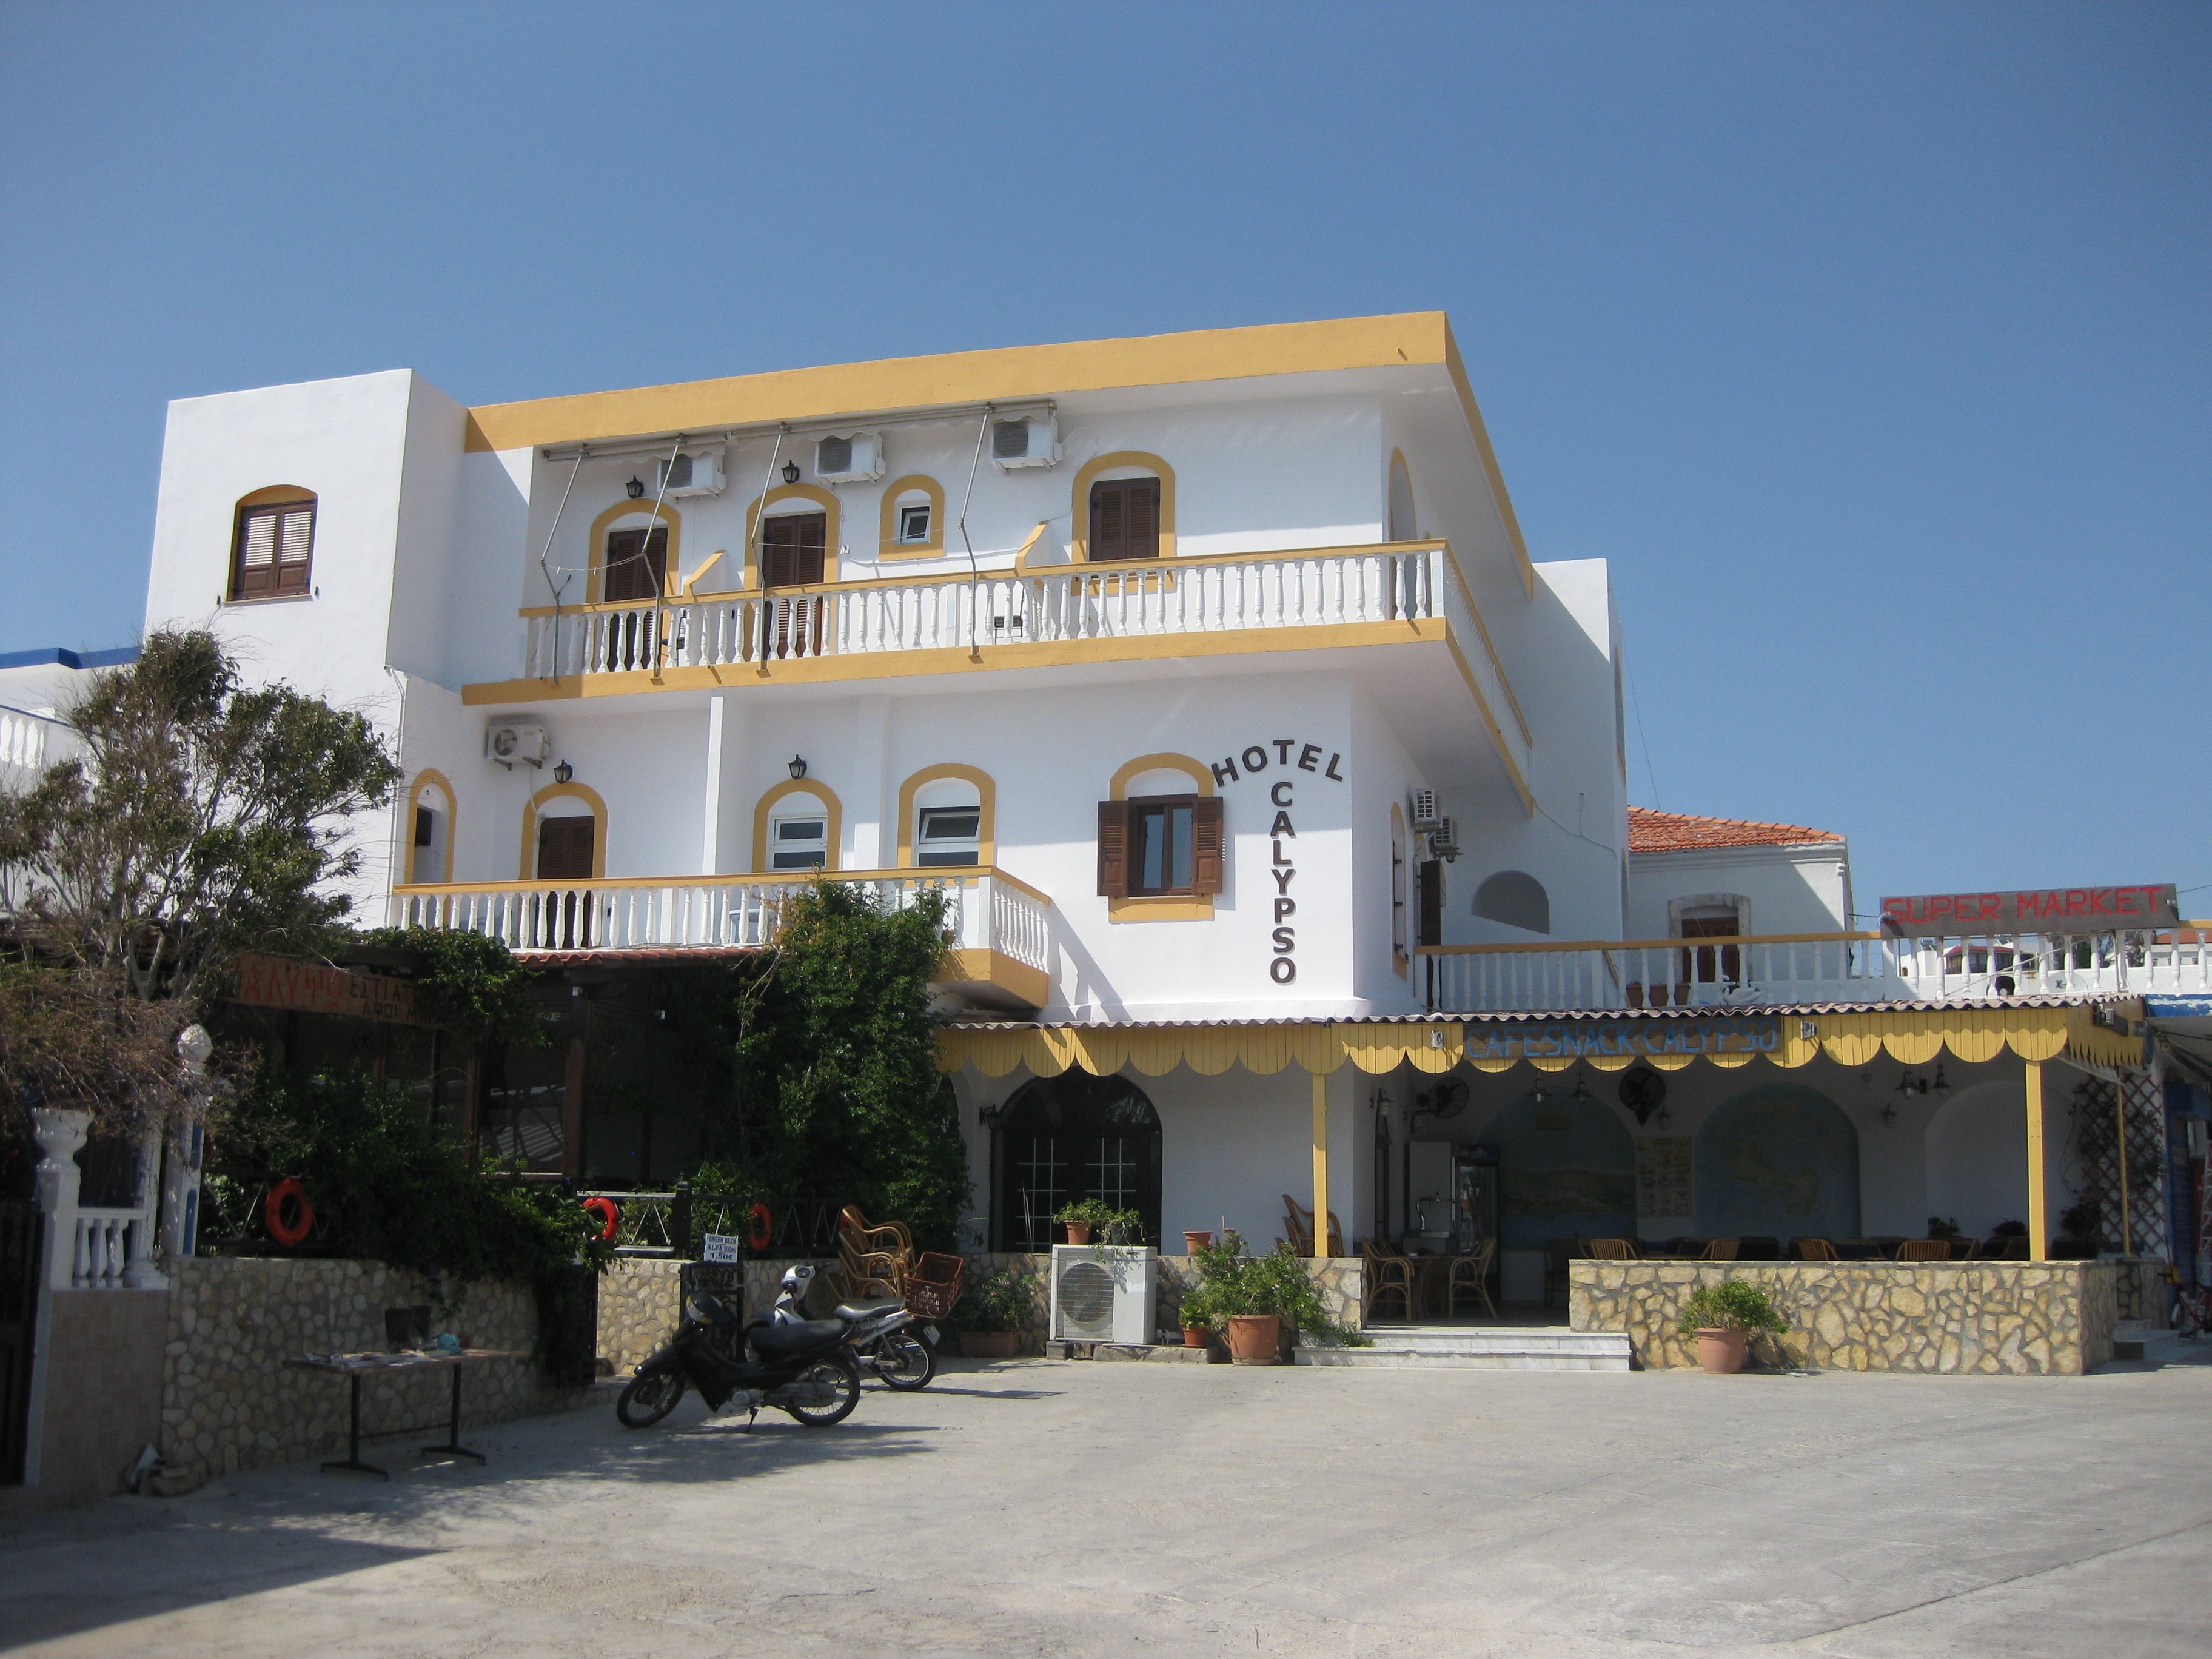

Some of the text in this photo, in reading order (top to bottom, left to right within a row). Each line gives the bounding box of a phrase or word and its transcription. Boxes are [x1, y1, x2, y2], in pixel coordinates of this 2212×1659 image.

[1211, 739, 1343, 788] HOTEL
[1270, 781, 1296, 984] CALYPSO
[1882, 886, 2165, 925] SUPER MARKET
[1643, 1018, 1777, 1053] CALYPSO
